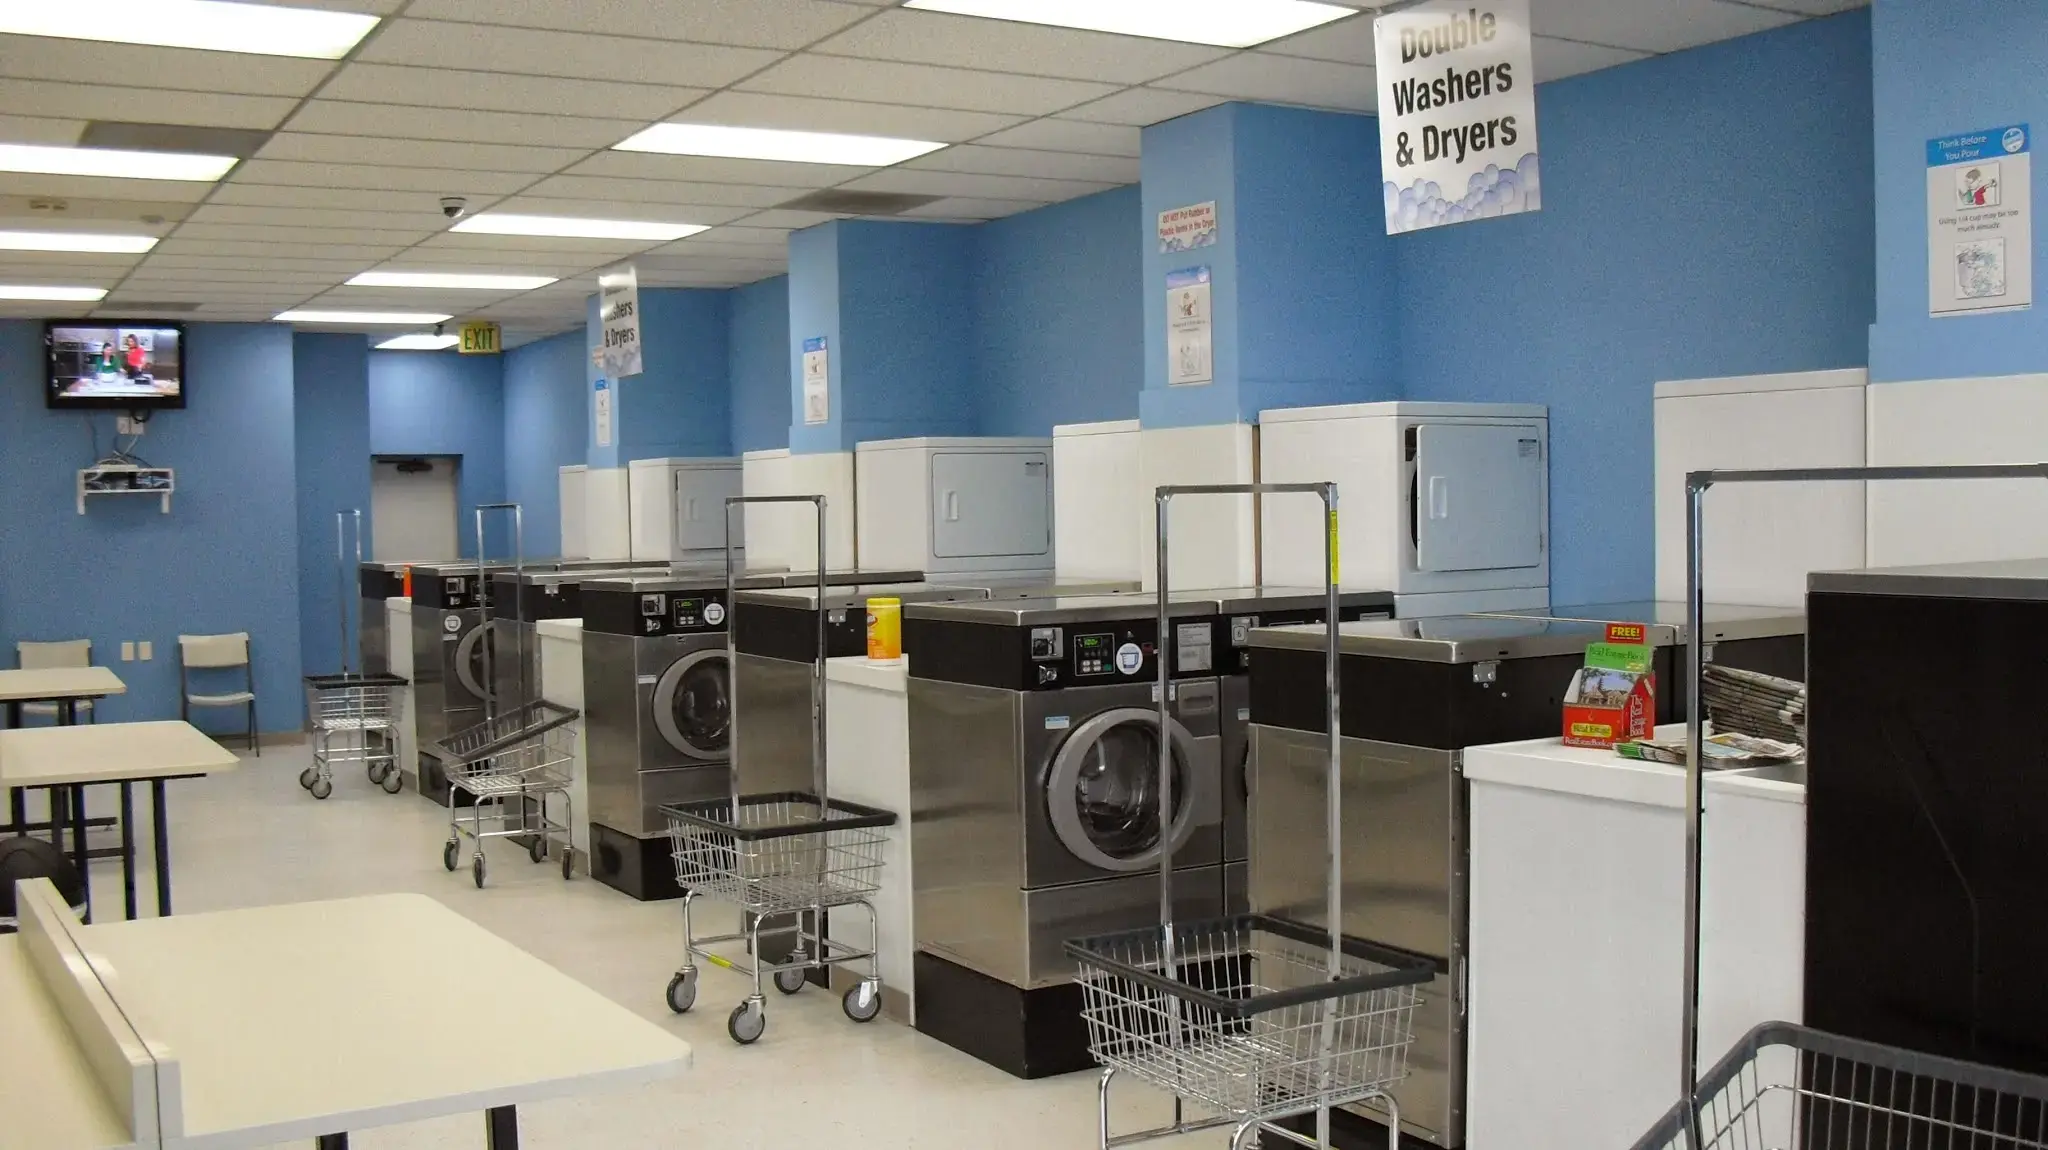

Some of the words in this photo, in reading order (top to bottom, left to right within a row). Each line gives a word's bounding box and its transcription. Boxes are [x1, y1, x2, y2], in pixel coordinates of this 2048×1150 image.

[1400, 8, 1497, 64] Double
[1393, 62, 1513, 116] Washers
[1396, 131, 1415, 168] &
[1422, 115, 1517, 164] Dryers
[1938, 139, 1960, 150] Think
[1961, 135, 1987, 146] Before
[1945, 152, 1960, 161] You
[1961, 149, 1980, 158] Pour
[1938, 217, 1957, 225] Using
[1957, 225, 1975, 233] much
[604, 301, 633, 322] shers
[464, 328, 494, 350] EXIT
[605, 330, 610, 348] &
[611, 327, 635, 348] Dryers
[1611, 626, 1640, 637] FREE!
[1631, 694, 1643, 705] The
[1630, 705, 1643, 716] Real
[1630, 726, 1645, 737] Book
